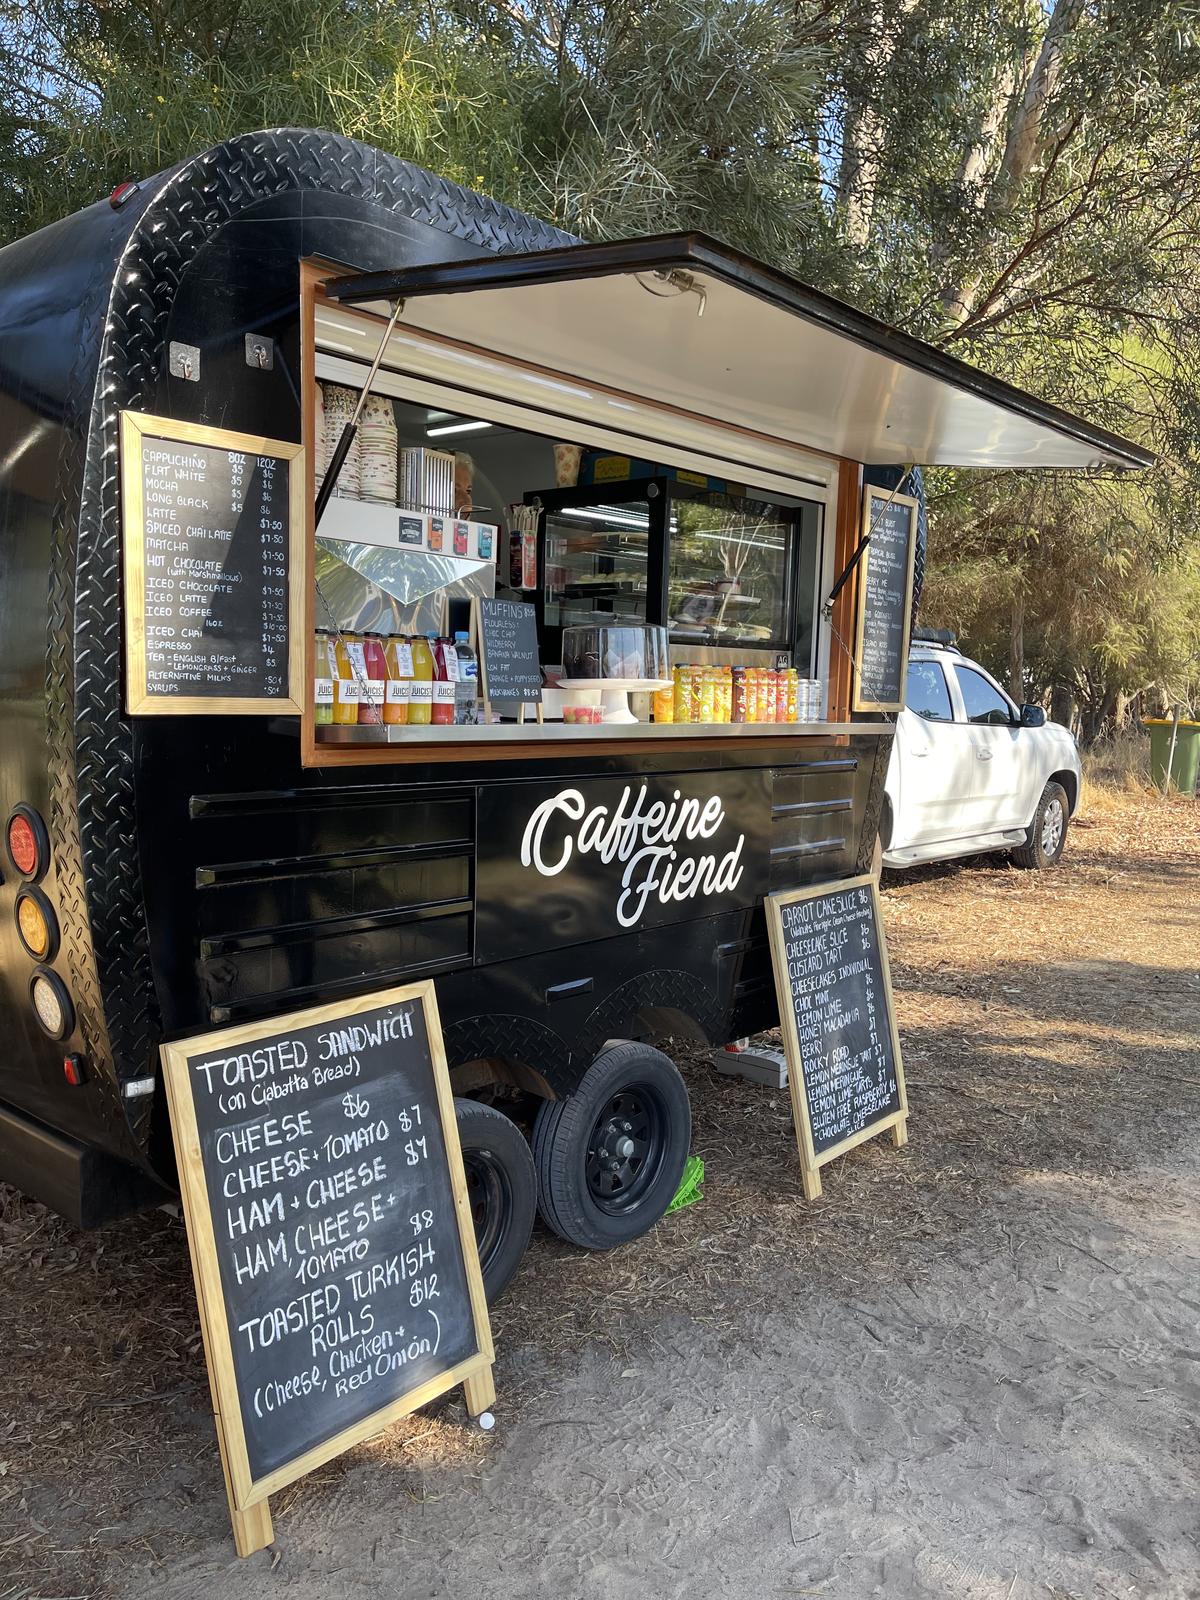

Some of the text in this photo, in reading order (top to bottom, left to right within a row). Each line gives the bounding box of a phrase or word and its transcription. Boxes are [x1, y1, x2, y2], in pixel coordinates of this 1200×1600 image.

[144, 464, 170, 476] FLAT
[230, 475, 242, 486] $5
[262, 480, 272, 490] $6
[146, 478, 272, 502] MOCHA $5 $6
[232, 464, 273, 479] $5 $6
[146, 491, 270, 514] LONG BLACK $5 $6
[147, 506, 176, 520] LATTE
[146, 520, 180, 536] SPICED
[208, 529, 232, 540] LATTE
[147, 538, 188, 551] MATCHA
[147, 554, 166, 566] HOT
[174, 557, 222, 572] CHOCOLATE
[145, 592, 207, 603] ICED LATTE
[146, 578, 174, 588] ICED
[179, 581, 232, 593] CHOCOLATE
[145, 606, 212, 616] ICED COFFEE
[482, 601, 522, 618] MUFFINS
[146, 626, 175, 636] ICED
[148, 640, 275, 655] ESPRESSO $4
[486, 639, 516, 648] WILDBERRY
[174, 662, 222, 672] LEMONGRASS
[266, 659, 276, 667] $5
[488, 648, 534, 660] BANANA WALNUT
[147, 683, 179, 692] SYRUPS
[521, 785, 725, 876] Caffeine
[616, 834, 744, 927] Fiend
[782, 889, 868, 928] CARROT CAKE SLICE $6
[786, 923, 870, 960] CHEESECAKE SLICE $6
[788, 938, 871, 980] CUSTARD TART $6
[792, 958, 874, 996] CHEESECAKES INDIVIDUAL
[794, 973, 874, 1012] CHOC MINT $6
[797, 988, 875, 1028] LEMON LIME $6
[800, 1002, 876, 1044] HONEY MACADAMIA $6
[196, 1010, 414, 1094] TOASTED SANDWICH
[802, 1016, 876, 1059] BERRY $7
[804, 1032, 878, 1074] ROCKY ROAD $7
[218, 1056, 361, 1114] (on Ciabatta Bread)
[806, 1069, 830, 1088] LEMON
[860, 1048, 872, 1063] TART
[874, 1044, 882, 1056] $7
[808, 1056, 886, 1102] LEMON MERINGUE $7
[810, 1068, 886, 1116] LEMON LIME TARTS $7
[812, 1080, 896, 1130] GLUTEN FREE RASPBERRY $6
[216, 1092, 370, 1164] CHEESE $6
[398, 1104, 422, 1133] $7
[818, 1094, 892, 1140] CHOCOLATE CHEESECAKE
[846, 1120, 866, 1136] SLICE
[227, 1192, 286, 1240] HAM
[291, 1195, 300, 1210] +
[306, 1156, 388, 1209] CHEESE
[294, 1192, 386, 1255] CHEESE
[295, 1209, 434, 1285] TOMATO $8
[238, 1238, 436, 1352] TOASTED TURKISH
[310, 1273, 440, 1357] ROLLS $12
[328, 1330, 394, 1378] Chicken
[335, 1364, 372, 1398] Red
